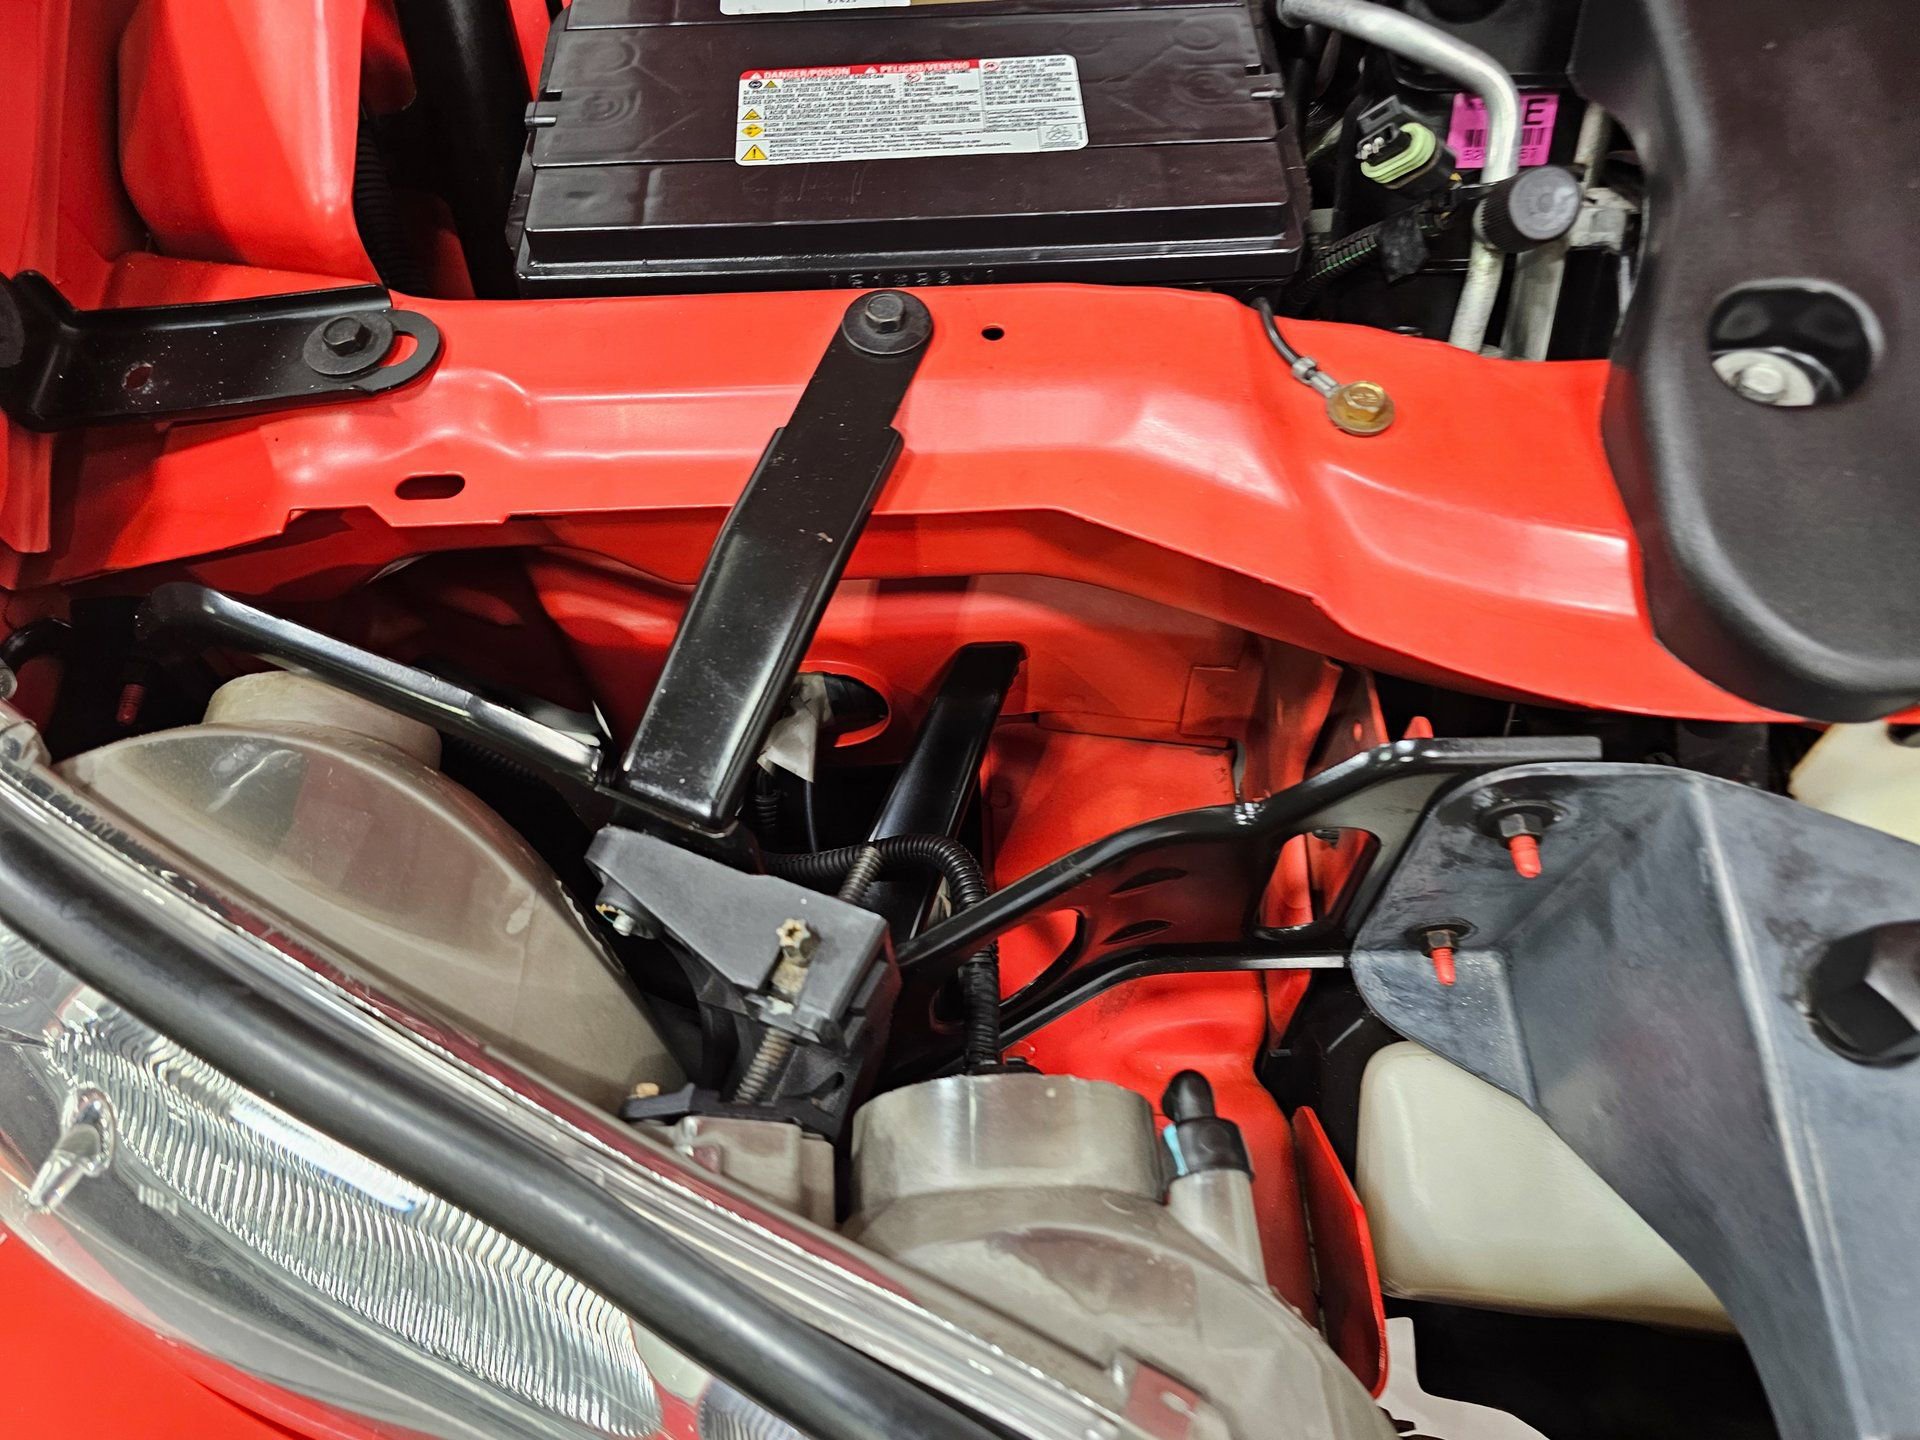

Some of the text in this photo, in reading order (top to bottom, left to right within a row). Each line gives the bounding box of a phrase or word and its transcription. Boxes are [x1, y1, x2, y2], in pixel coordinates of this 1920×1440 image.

[763, 67, 851, 79] DANGER/POISON
[880, 61, 970, 73] PELIGRO/VENENO
[1524, 98, 1547, 125] E
